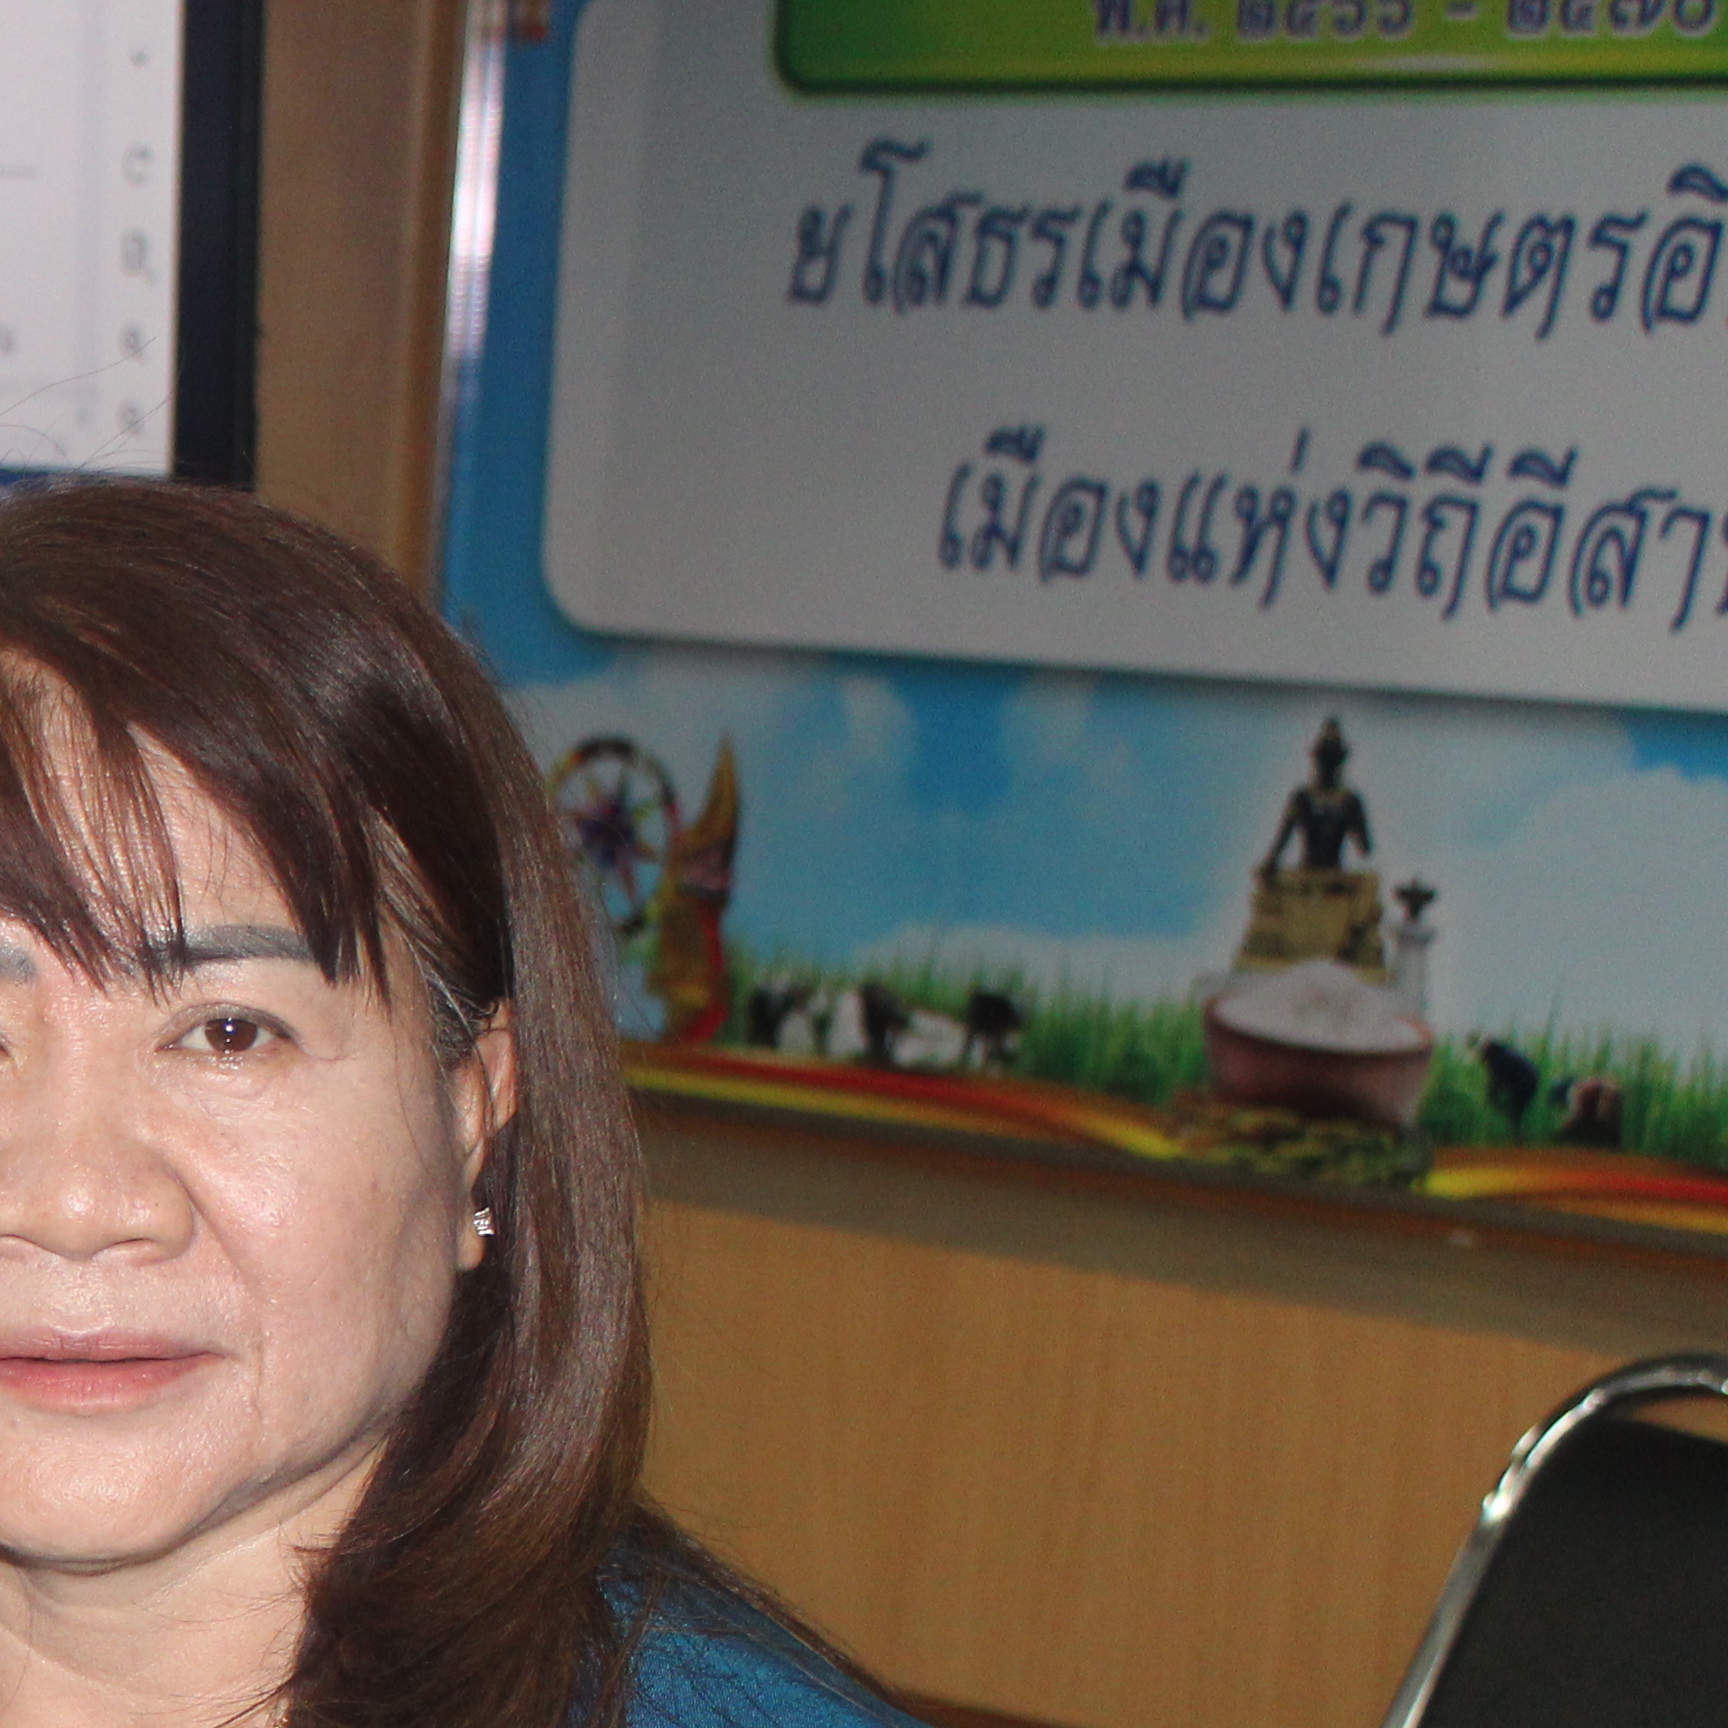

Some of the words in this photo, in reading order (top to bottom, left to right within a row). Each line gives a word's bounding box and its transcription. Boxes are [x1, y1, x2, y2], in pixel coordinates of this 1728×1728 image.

[784, 134, 1728, 338] ยโสธรเมืองเกษตรอิ
[937, 424, 1728, 630] เมืองแห่งวิถีอีสา
